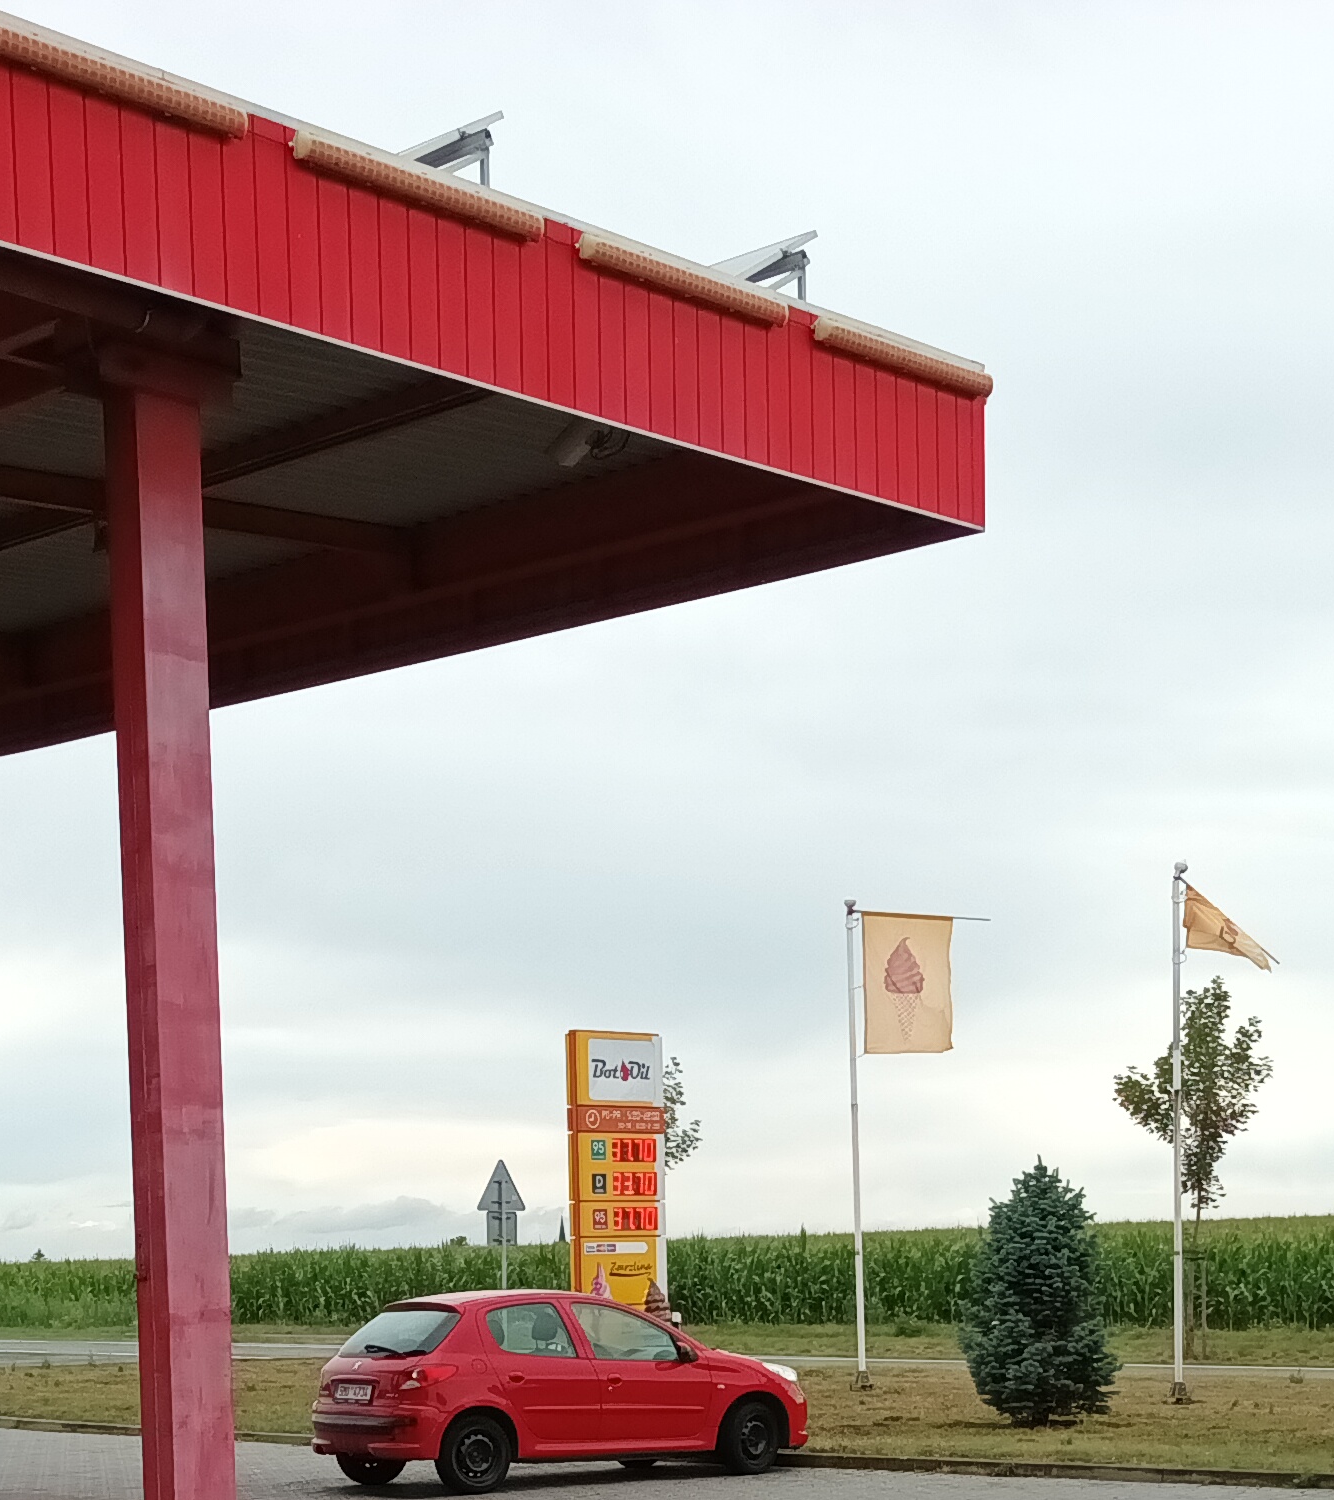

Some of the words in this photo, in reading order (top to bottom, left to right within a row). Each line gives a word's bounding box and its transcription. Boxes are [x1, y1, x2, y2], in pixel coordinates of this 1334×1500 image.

[591, 1058, 620, 1079] Bot
[592, 1142, 605, 1154] 95
[595, 1175, 604, 1188] D
[594, 1211, 606, 1223] 95
